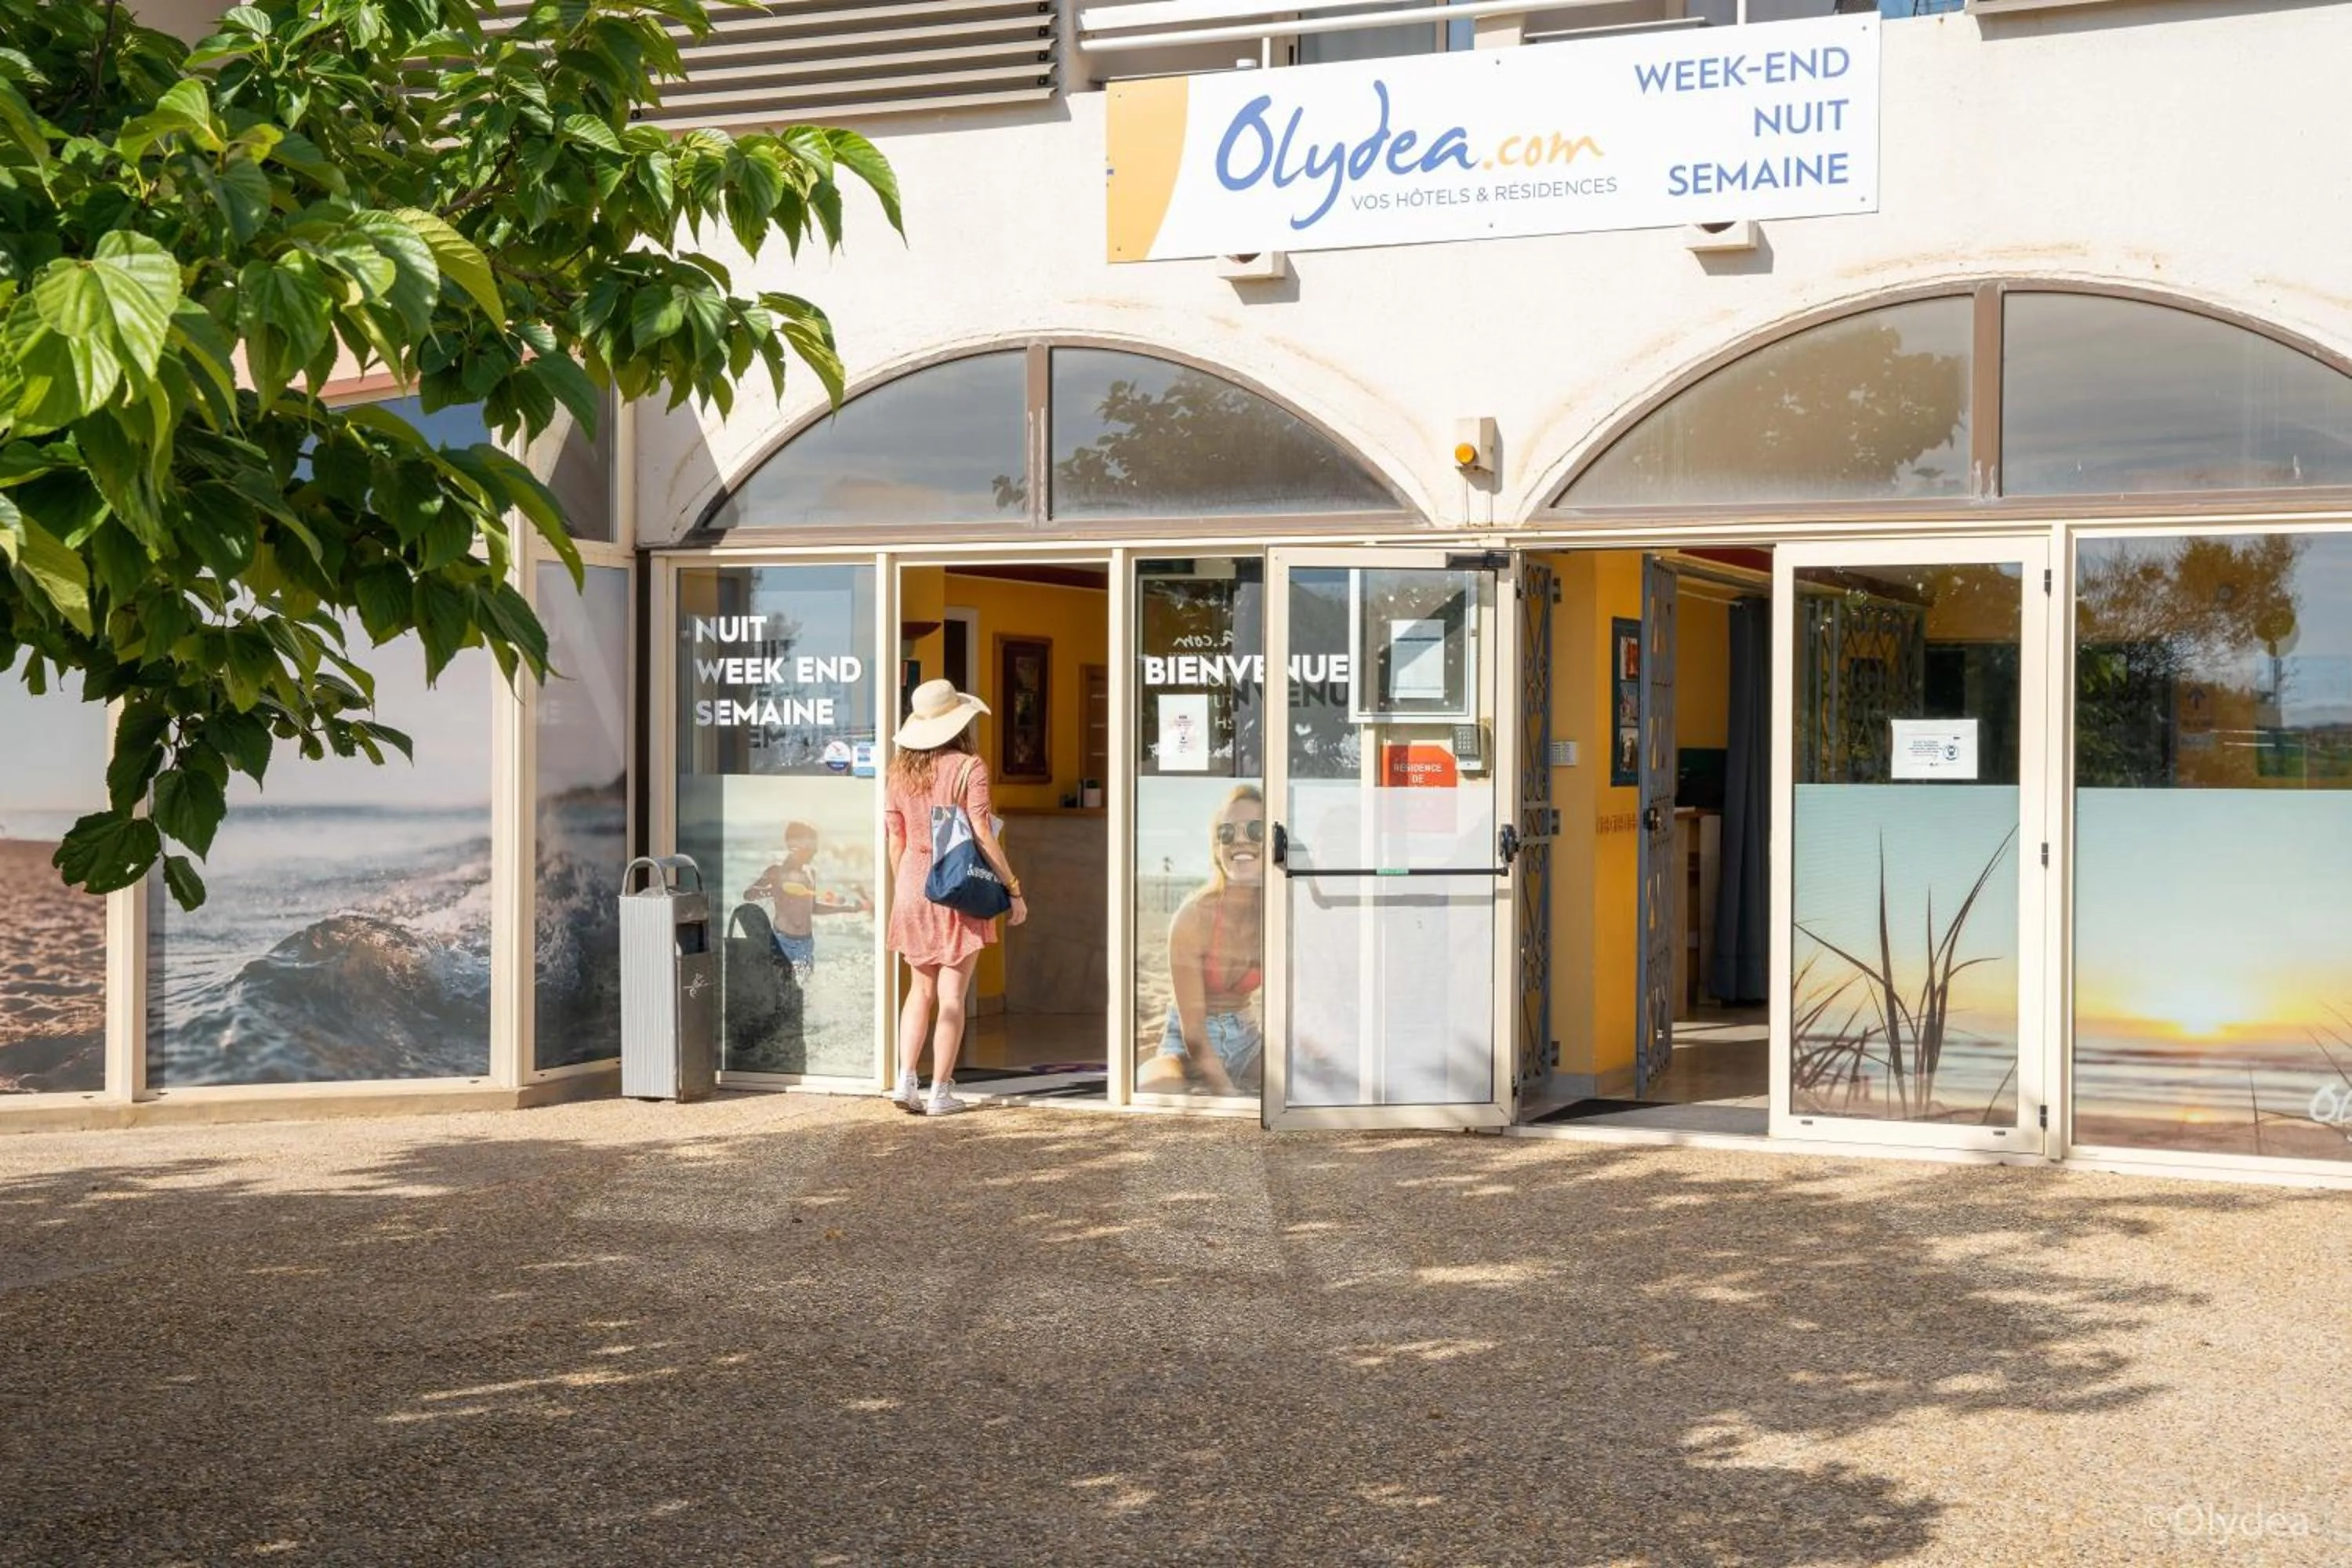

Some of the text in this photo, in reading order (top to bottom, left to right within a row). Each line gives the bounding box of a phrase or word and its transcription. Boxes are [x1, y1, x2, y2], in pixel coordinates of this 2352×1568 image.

[1635, 47, 1849, 95] WEEK-END
[1755, 99, 1849, 136] NUIT
[1668, 153, 1848, 196] SEMAINE
[1351, 177, 1618, 211] VOS HÔTELS & RÉSIDENCES
[695, 615, 767, 643] NUIT
[695, 656, 862, 684] WEEK END
[695, 699, 834, 725] SEMAINE
[1412, 774, 1425, 783] DE
